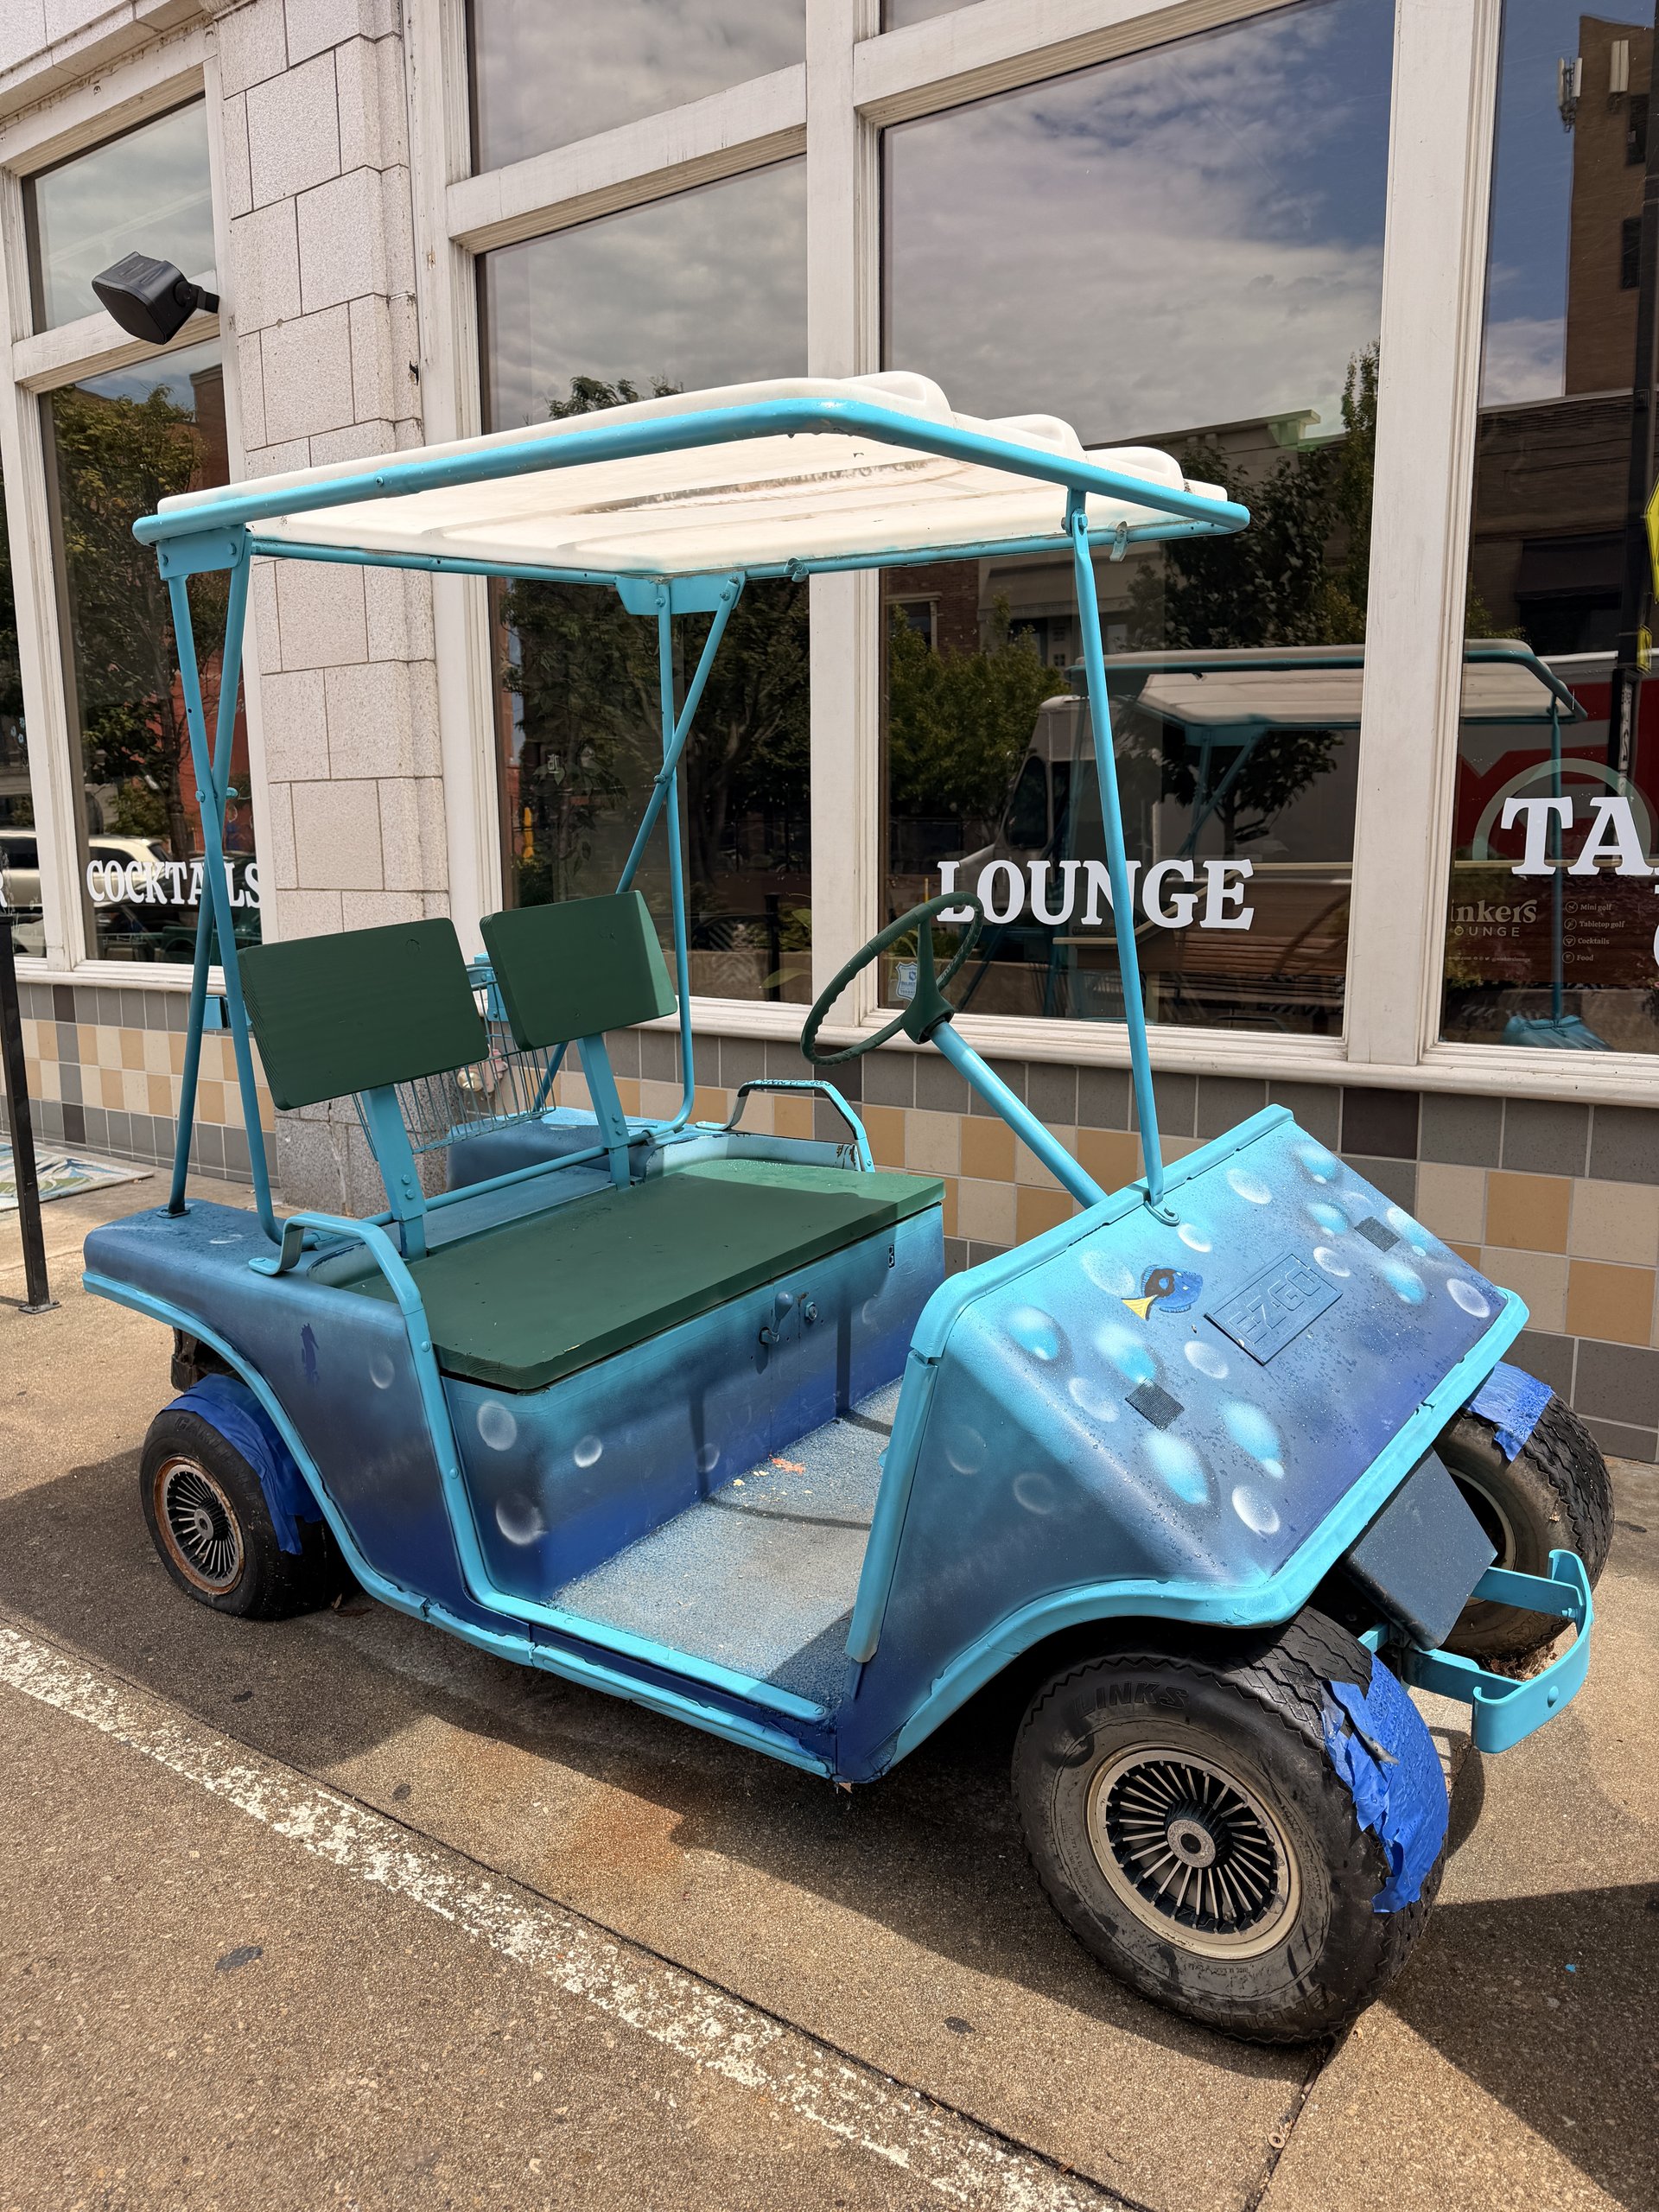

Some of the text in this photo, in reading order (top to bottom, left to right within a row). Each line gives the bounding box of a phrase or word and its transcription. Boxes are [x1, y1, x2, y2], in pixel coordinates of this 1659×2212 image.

[87, 860, 259, 907] COCKTALS
[937, 859, 1254, 931] LOUNGE
[1579, 920, 1625, 930] Tabletop golf
[1598, 903, 1612, 912] golf
[1075, 1681, 1190, 1719] LINKS
